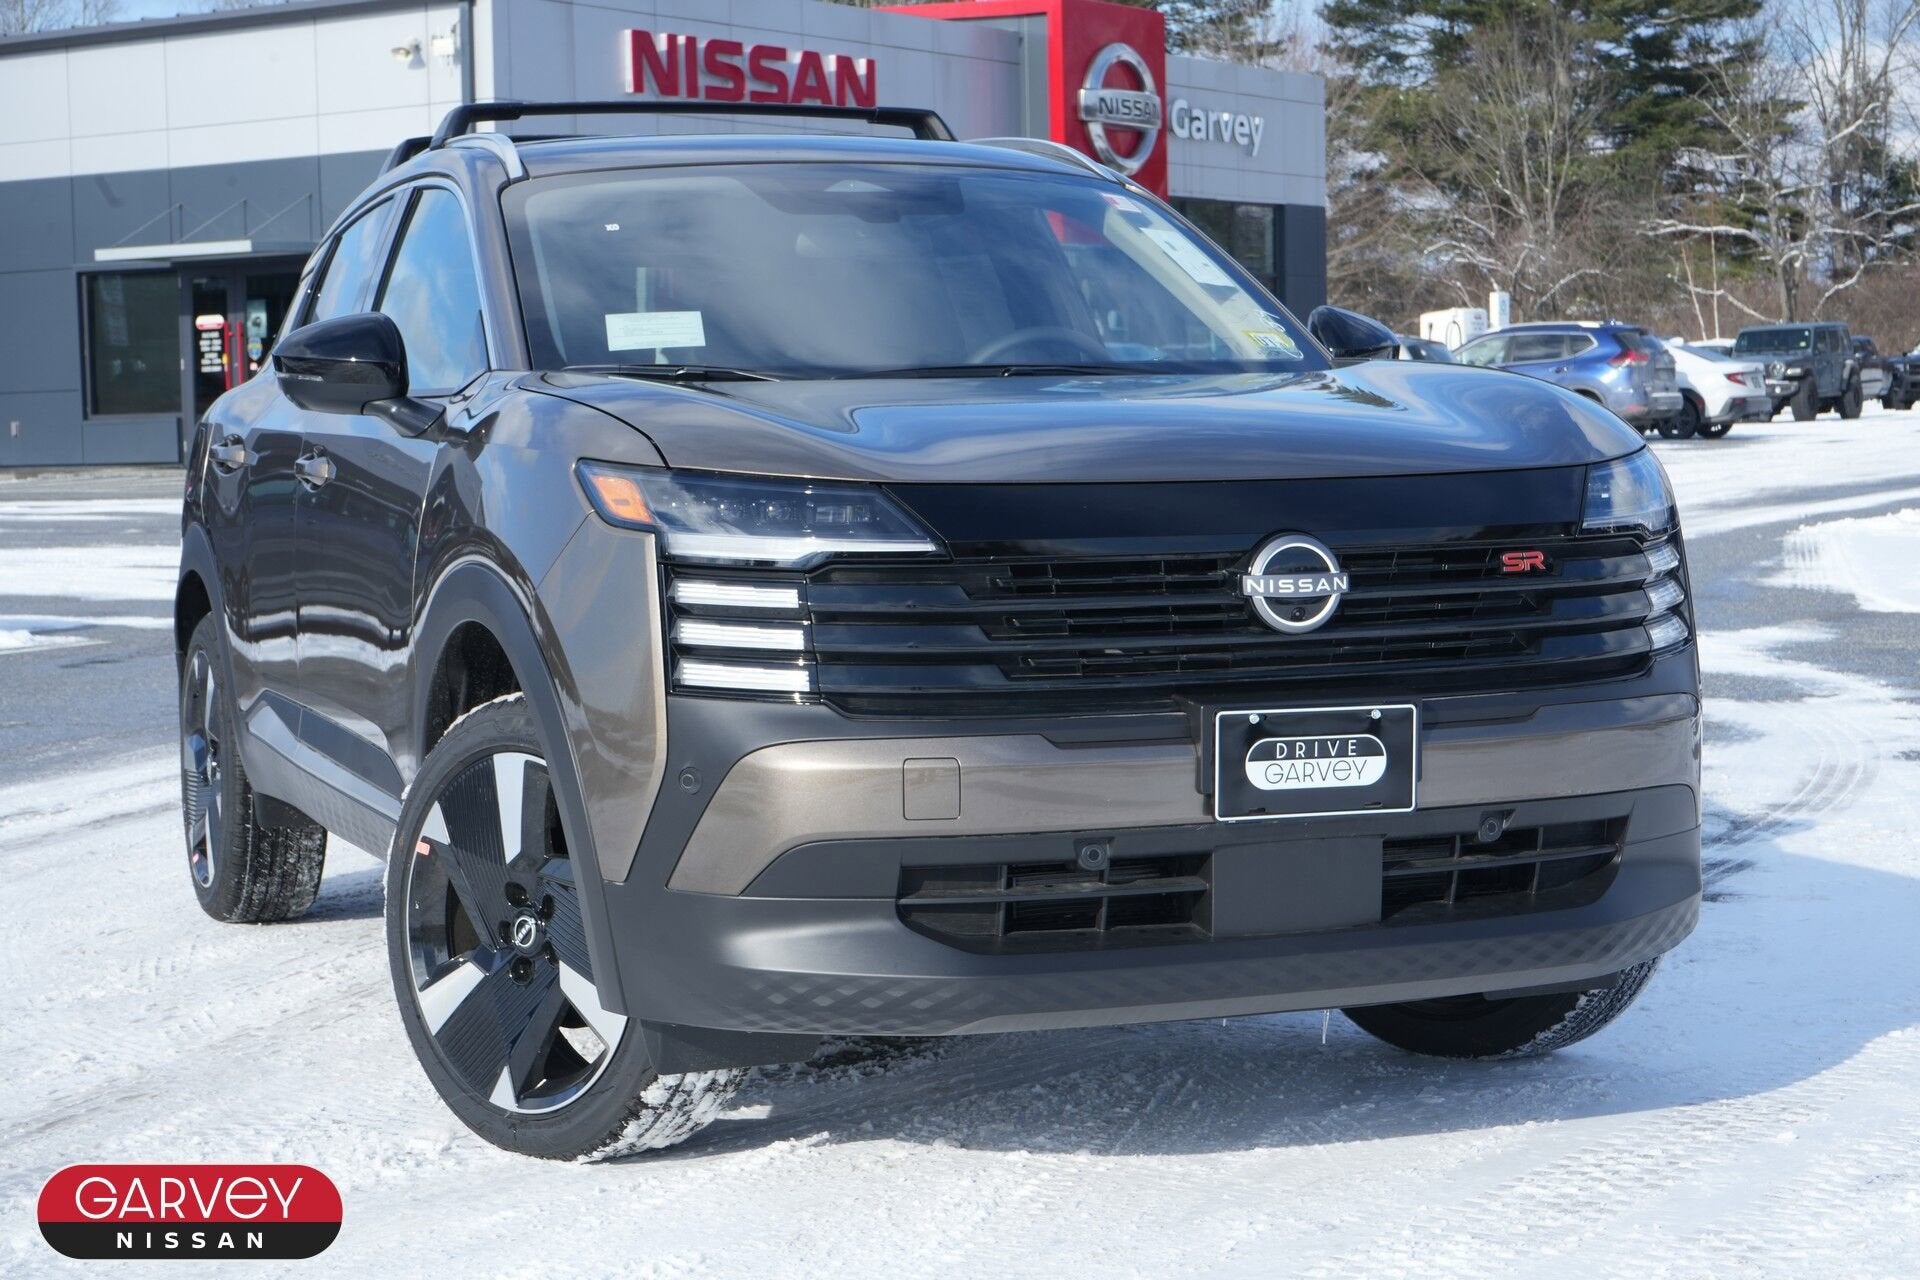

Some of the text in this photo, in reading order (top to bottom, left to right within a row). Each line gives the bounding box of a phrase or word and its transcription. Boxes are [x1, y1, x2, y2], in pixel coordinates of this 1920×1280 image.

[626, 29, 877, 107] NISSAN
[1099, 96, 1160, 118] NISSAN
[1170, 98, 1265, 157] Garvey
[1502, 551, 1546, 572] SR
[1246, 575, 1348, 593] NISSAN
[1275, 739, 1358, 759] DRIVE
